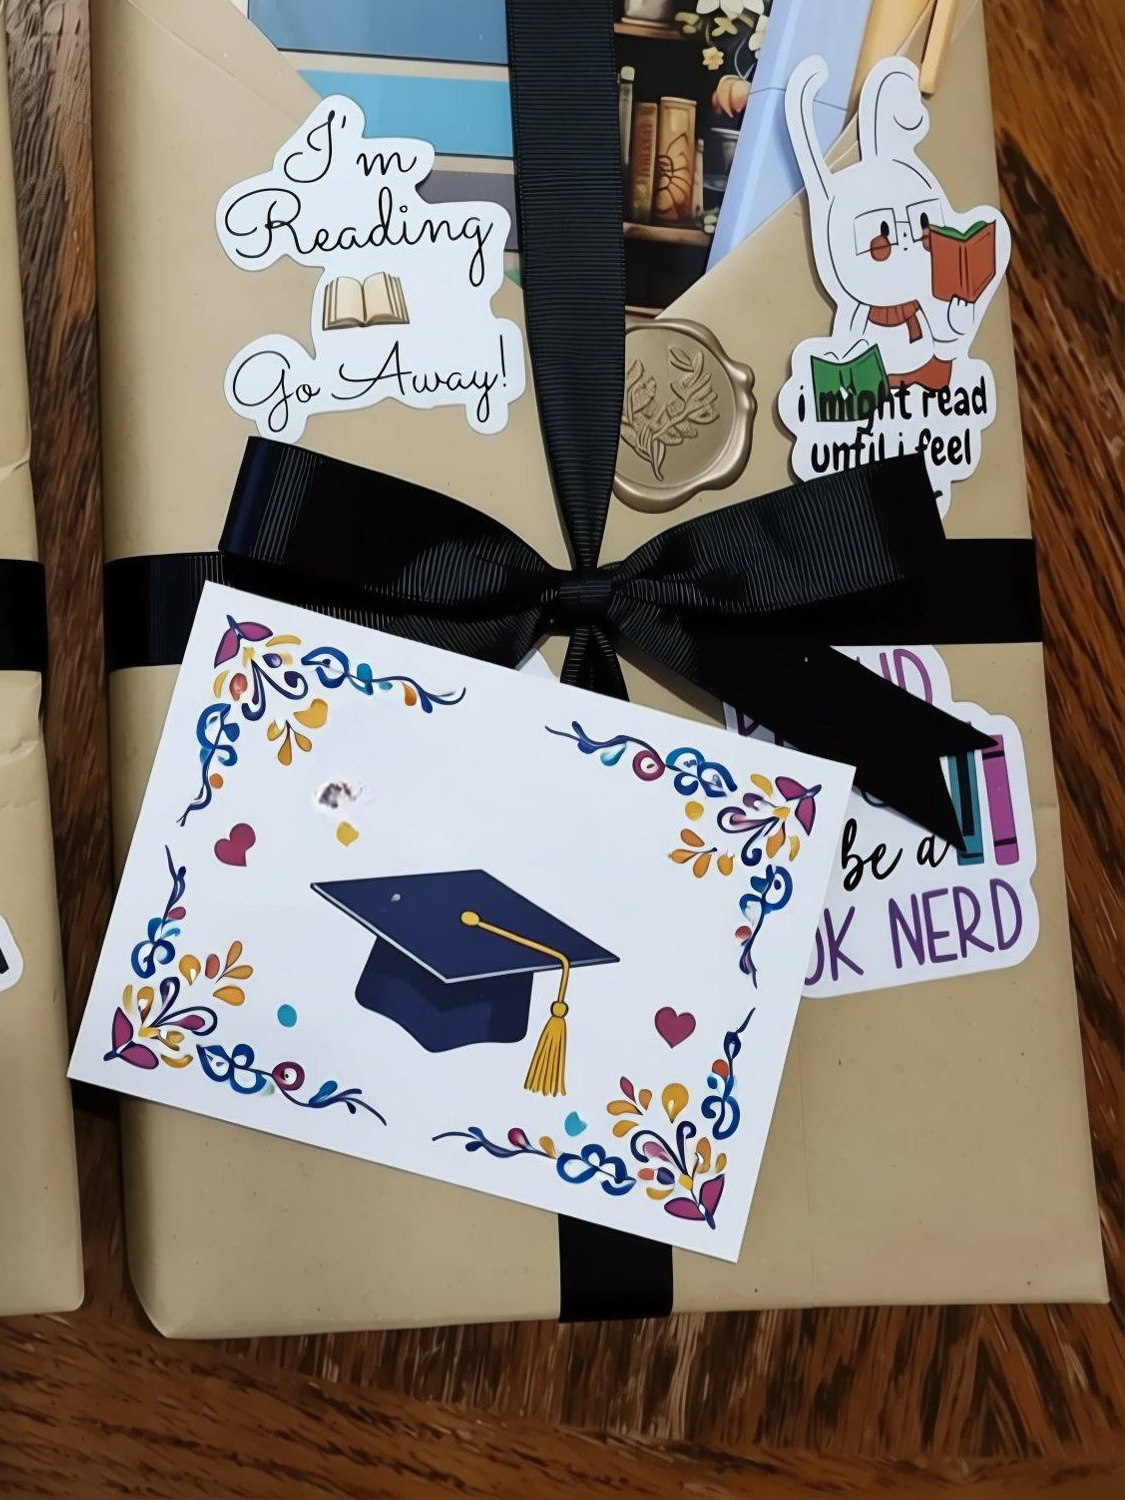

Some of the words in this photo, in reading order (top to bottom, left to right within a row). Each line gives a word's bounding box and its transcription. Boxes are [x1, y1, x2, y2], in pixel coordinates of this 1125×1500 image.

[283, 109, 419, 184] I'm
[224, 185, 495, 288] Reading
[232, 350, 322, 433] Go
[331, 334, 508, 423] Away!
[818, 379, 913, 434] might
[922, 374, 988, 419] read
[915, 427, 972, 467] feel
[840, 817, 904, 893] be
[887, 877, 1024, 970] NERD
